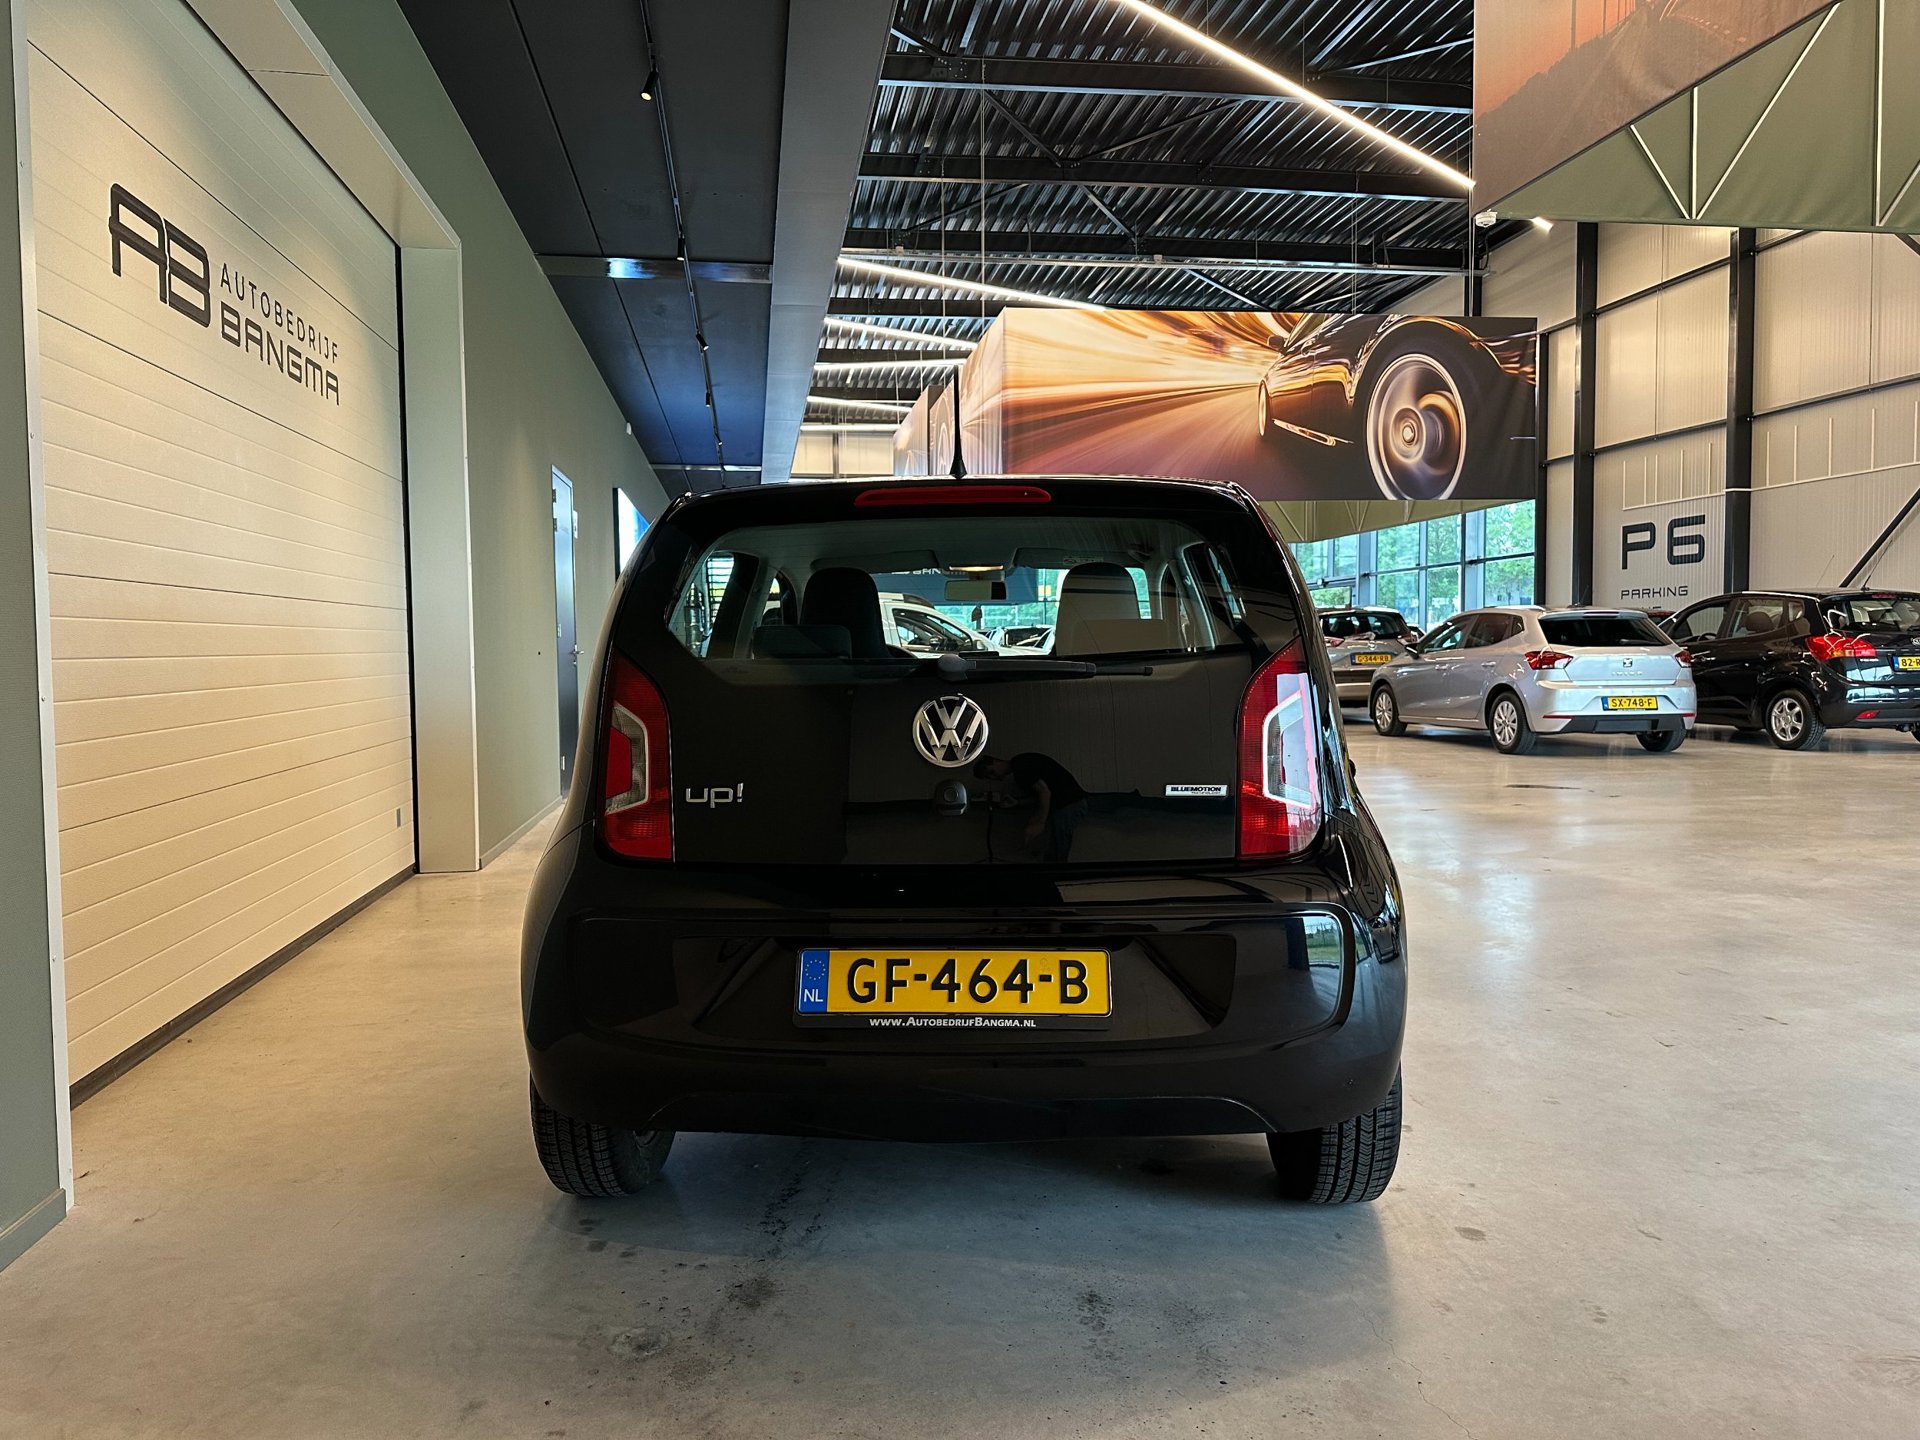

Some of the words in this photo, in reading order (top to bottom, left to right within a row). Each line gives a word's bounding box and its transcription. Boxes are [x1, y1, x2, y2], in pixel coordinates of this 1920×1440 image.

[109, 183, 211, 327] AB
[220, 263, 338, 363] AUTOBEDRIJF
[221, 301, 340, 405] BANGMA
[1621, 585, 1688, 600] PARKING
[1611, 698, 1653, 708] SX-748-F
[685, 782, 744, 808] up!
[803, 988, 824, 1002] NL
[847, 958, 1089, 1004] GF-464-B
